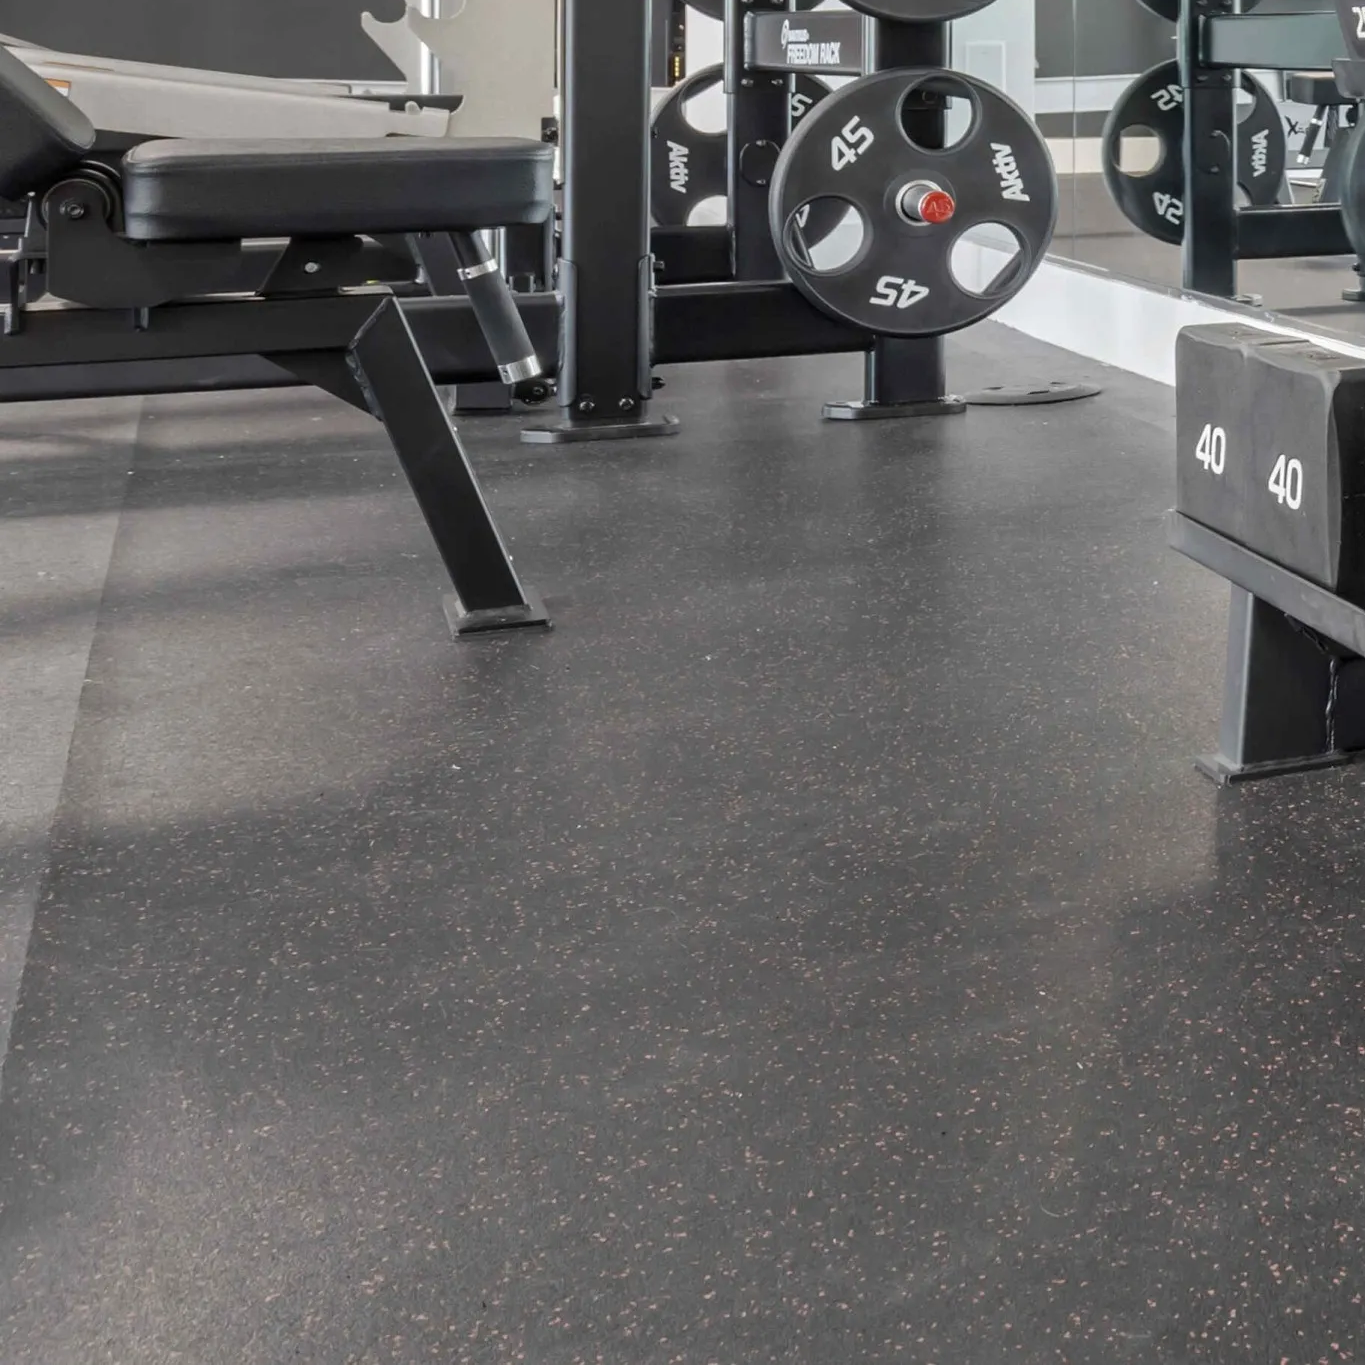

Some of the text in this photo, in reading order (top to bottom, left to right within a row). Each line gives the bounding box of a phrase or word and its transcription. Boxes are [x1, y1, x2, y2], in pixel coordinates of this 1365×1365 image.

[666, 139, 690, 194] Aktiv
[830, 115, 875, 171] 45
[989, 142, 1031, 202] Aktiv
[868, 275, 930, 309] 45
[1195, 423, 1227, 475] 40
[1267, 454, 1303, 510] 40
